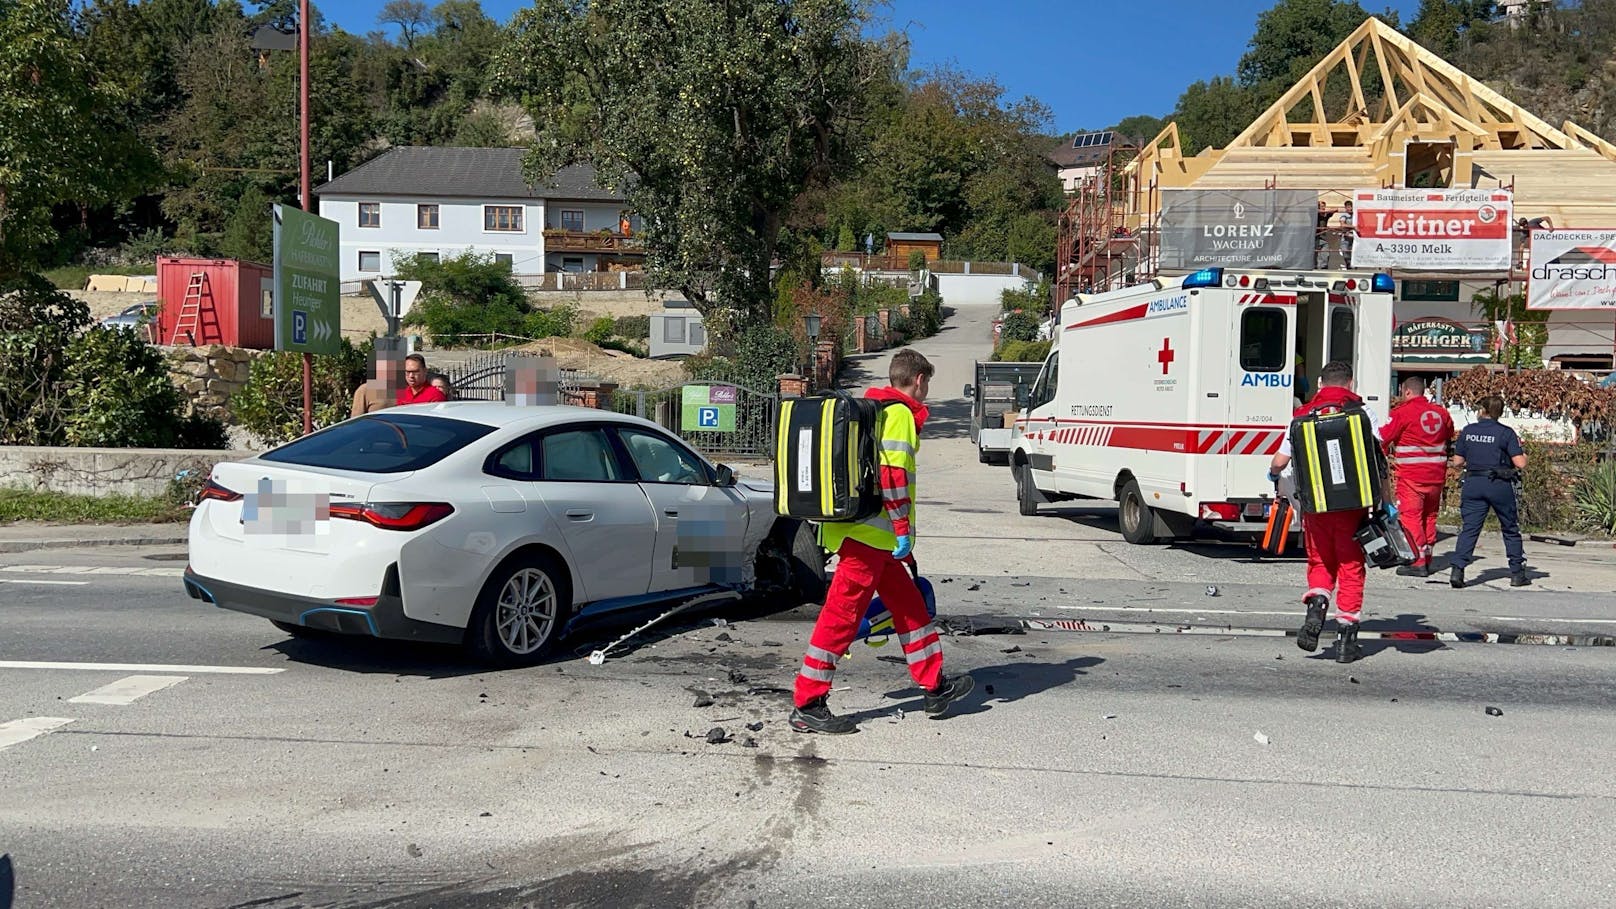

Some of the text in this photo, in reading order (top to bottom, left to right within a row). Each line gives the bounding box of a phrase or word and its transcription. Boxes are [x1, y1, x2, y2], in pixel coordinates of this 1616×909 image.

[1445, 194, 1489, 203] Fertigteile
[1204, 224, 1274, 237] LORENZ
[1375, 213, 1475, 236] Leitner
[1212, 240, 1264, 249] WACHAU
[1421, 244, 1452, 254] Melk
[1257, 254, 1282, 262] LIVING
[292, 274, 327, 293] ZUFAHRT
[292, 291, 322, 312] Heuriger
[1149, 296, 1187, 313] AMBULANCE
[1241, 373, 1292, 387] AMBU
[703, 410, 714, 425] P
[1071, 405, 1113, 417] RETTUNGSDIENST
[1465, 433, 1496, 443] POLIZEI
